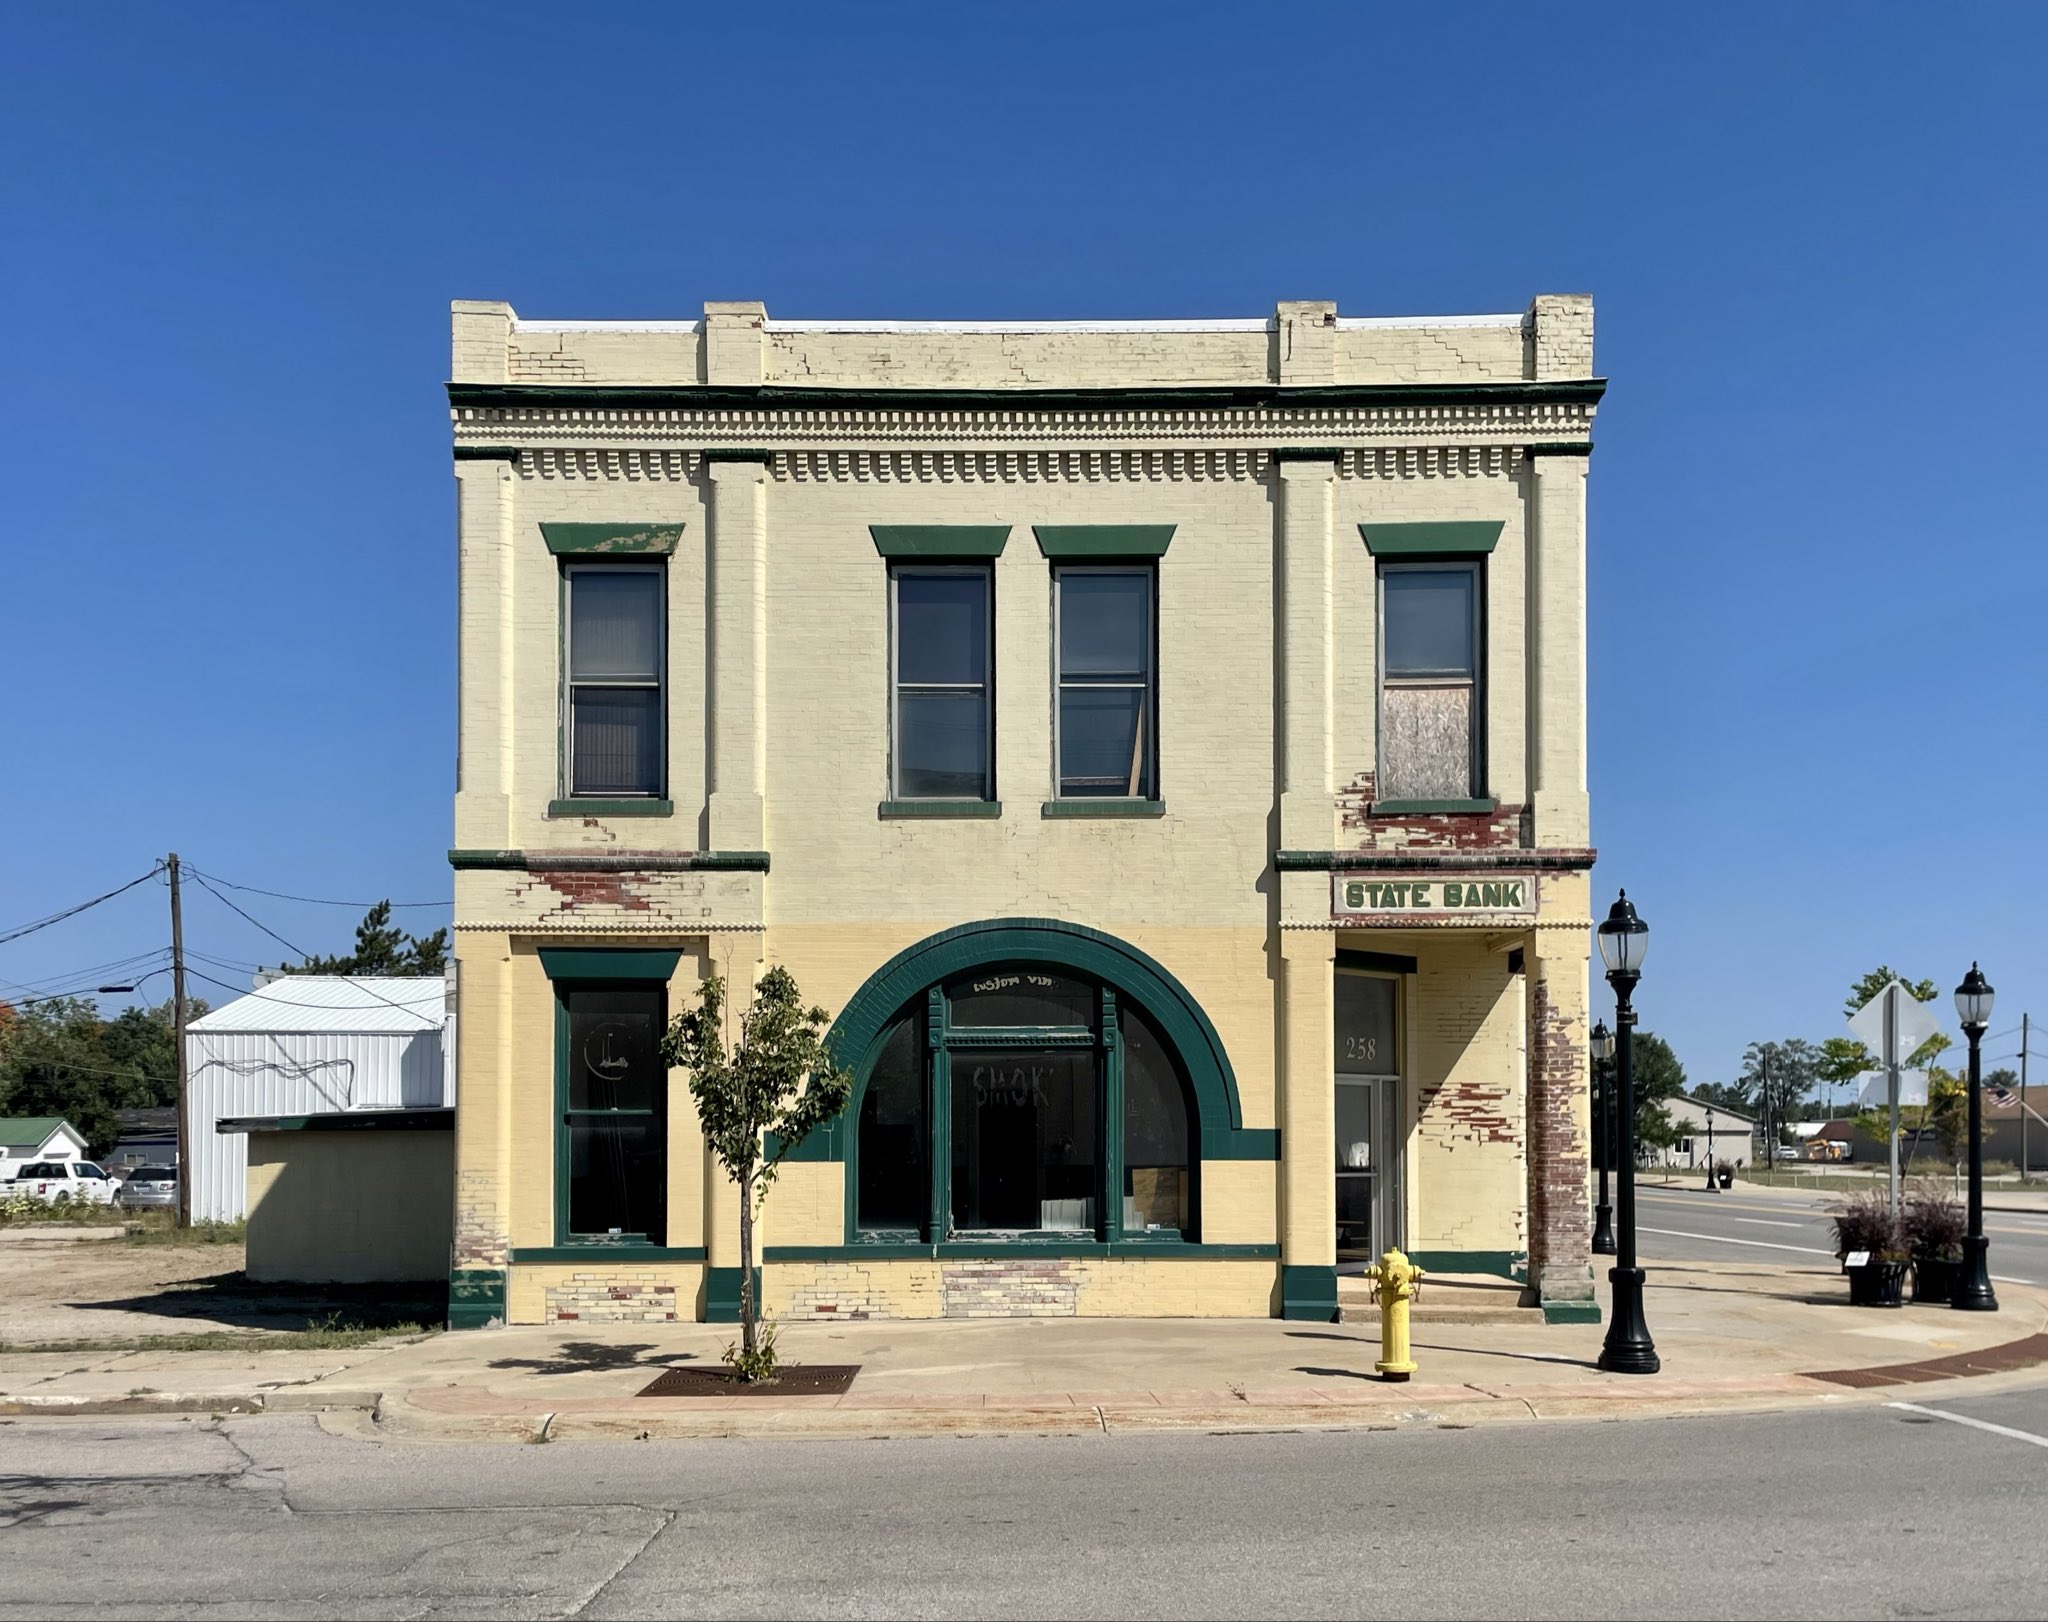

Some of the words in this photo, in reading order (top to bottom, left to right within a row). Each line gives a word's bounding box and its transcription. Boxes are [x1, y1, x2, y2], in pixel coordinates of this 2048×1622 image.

[1346, 884, 1430, 908] STATE
[1443, 884, 1521, 908] BANK
[1346, 1037, 1376, 1060] 258
[973, 1066, 1054, 1107] SMOK
